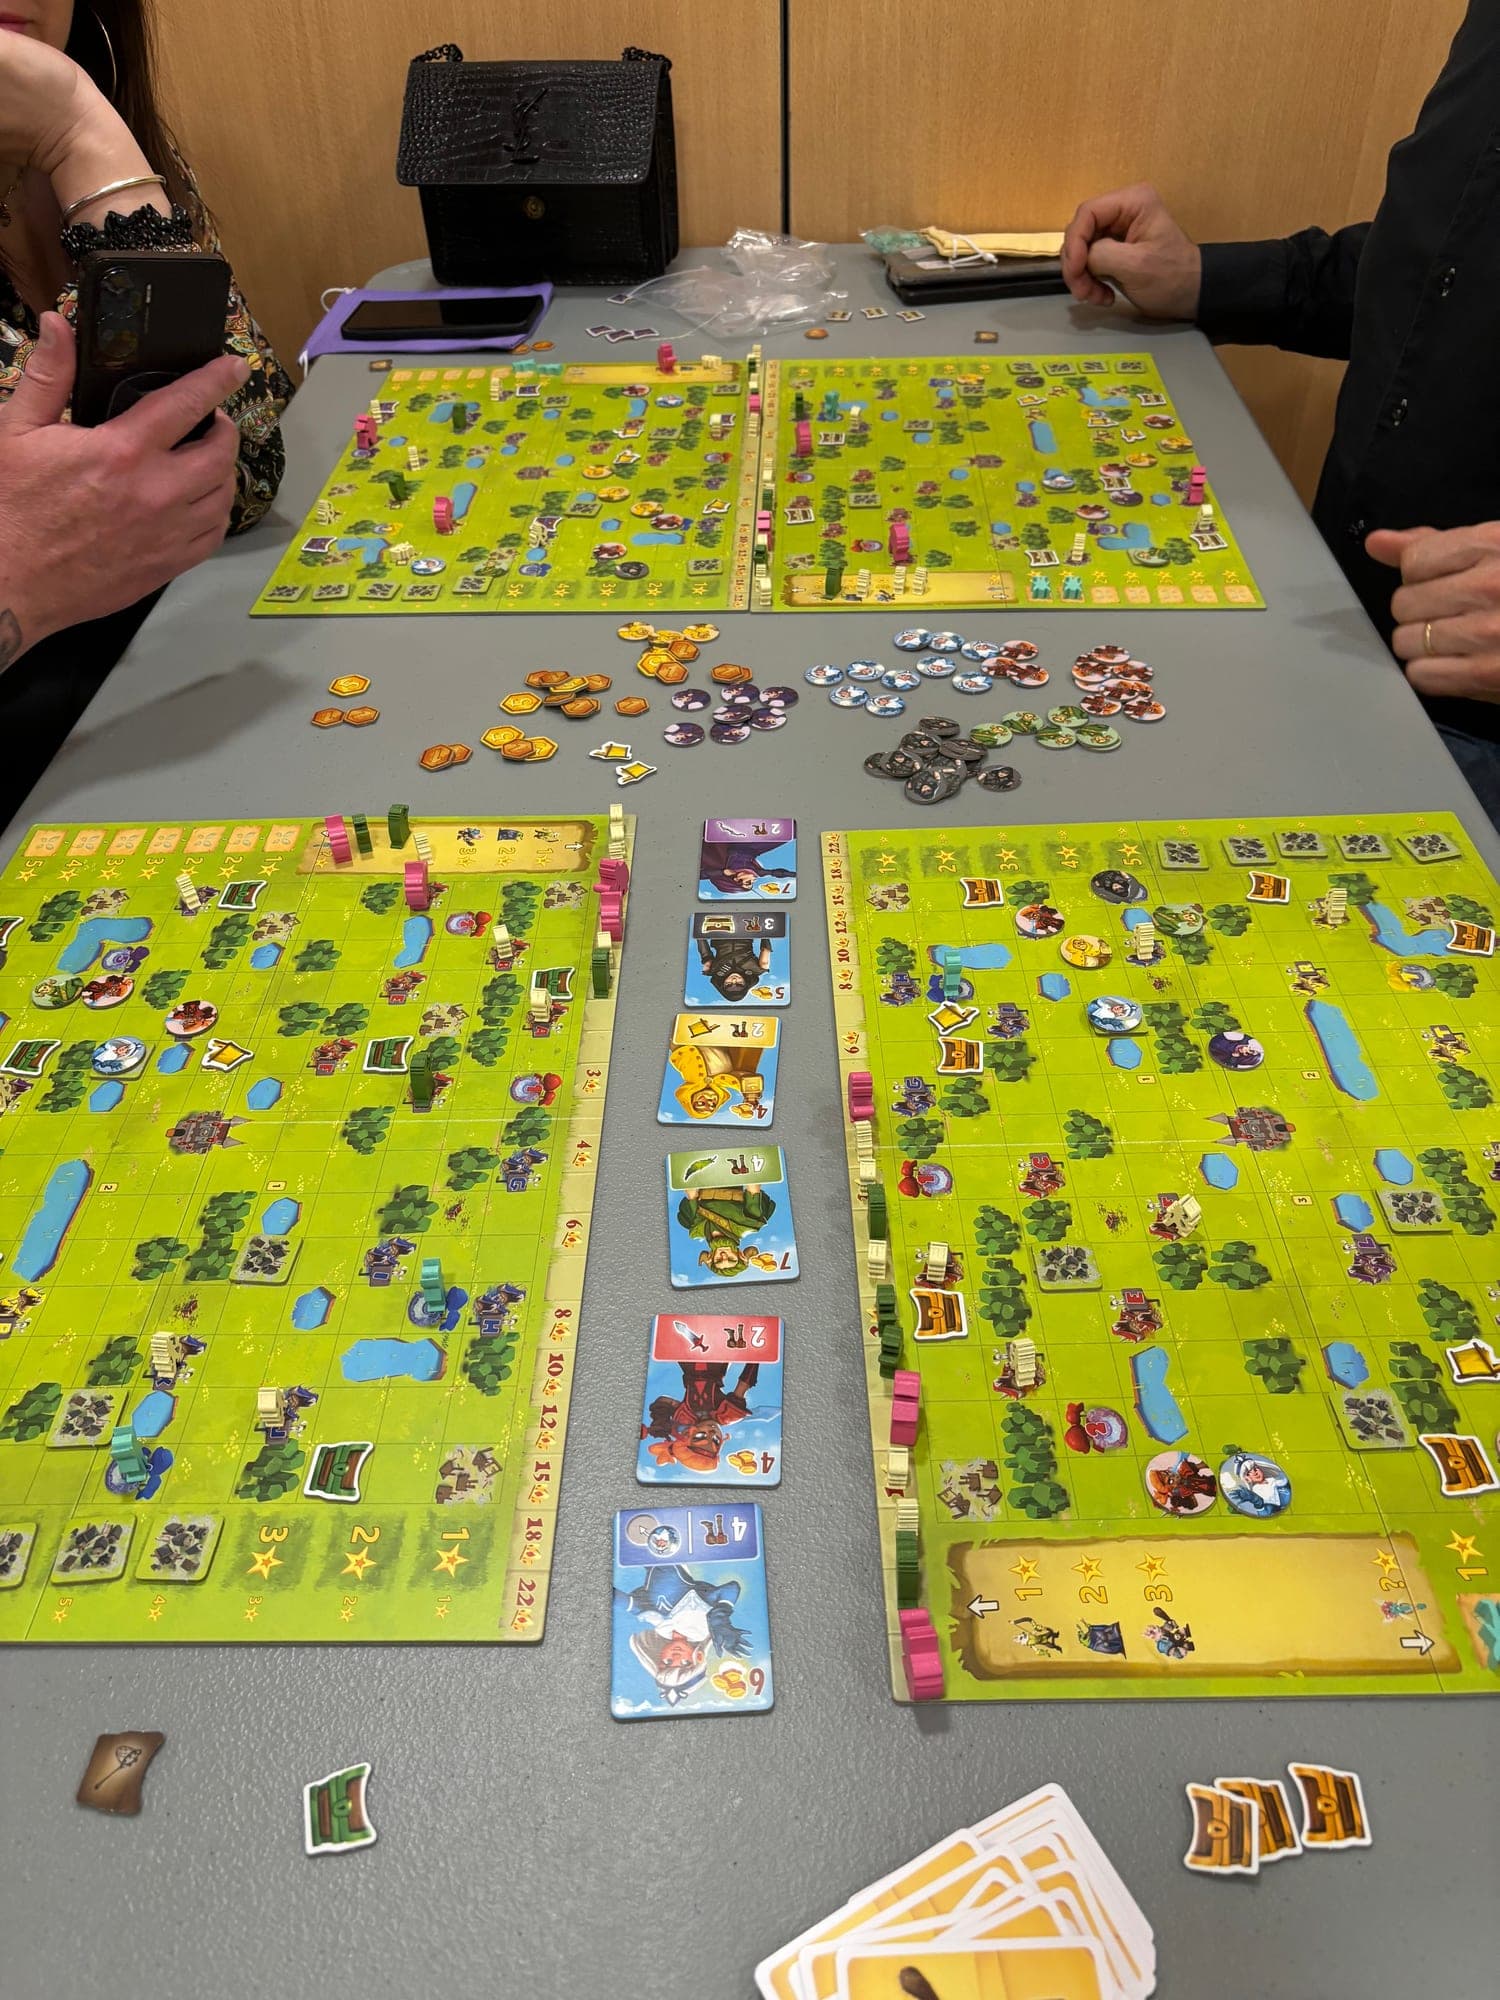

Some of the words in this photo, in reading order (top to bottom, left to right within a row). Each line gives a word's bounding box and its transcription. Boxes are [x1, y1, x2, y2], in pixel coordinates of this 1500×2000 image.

[771, 823, 780, 834] 2
[458, 847, 477, 855] 3
[498, 847, 516, 855] 2
[829, 841, 840, 854] 22
[25, 859, 44, 868] 5
[65, 858, 83, 868] 4
[106, 857, 125, 866] 3
[146, 856, 165, 865] 3
[185, 856, 204, 865] 2
[224, 855, 243, 865] 2
[264, 856, 283, 864] 1
[1061, 859, 1080, 869] 4
[1122, 857, 1143, 866] 5
[938, 864, 957, 873] 2
[999, 863, 1019, 871] 3
[831, 868, 842, 879] 18
[781, 883, 791, 894] 7
[833, 894, 844, 906] 15
[764, 917, 774, 930] 3
[835, 920, 847, 934] 12
[836, 948, 850, 964] 10
[838, 982, 853, 990] 8
[775, 986, 785, 999] 5
[752, 1023, 765, 1037] 2
[845, 1046, 860, 1054] 6
[586, 1068, 601, 1078] 3
[757, 1104, 768, 1119] 4
[576, 1140, 593, 1149] 4
[751, 1155, 765, 1172] 4
[565, 1219, 583, 1229] 6
[779, 1252, 791, 1270] 7
[554, 1308, 572, 1319] 8
[751, 1326, 766, 1347] 2
[547, 1352, 565, 1377] 10
[539, 1404, 558, 1430] 12
[760, 1452, 776, 1474] 4
[534, 1461, 552, 1482] 15
[258, 1525, 289, 1543] 3
[350, 1525, 381, 1545] 2
[442, 1528, 470, 1541] 1
[526, 1517, 543, 1542] 18
[731, 1516, 747, 1542] 4
[1456, 1567, 1489, 1581] 1
[1379, 1576, 1406, 1592] ?
[516, 1577, 537, 1607] 22
[1014, 1587, 1043, 1602] 1
[1079, 1585, 1109, 1605] 2
[1143, 1584, 1173, 1602] 3
[59, 1597, 73, 1607] 5
[152, 1594, 167, 1605] 4
[248, 1595, 263, 1605] 3
[343, 1595, 357, 1606] 2
[749, 1668, 765, 1696] 6
